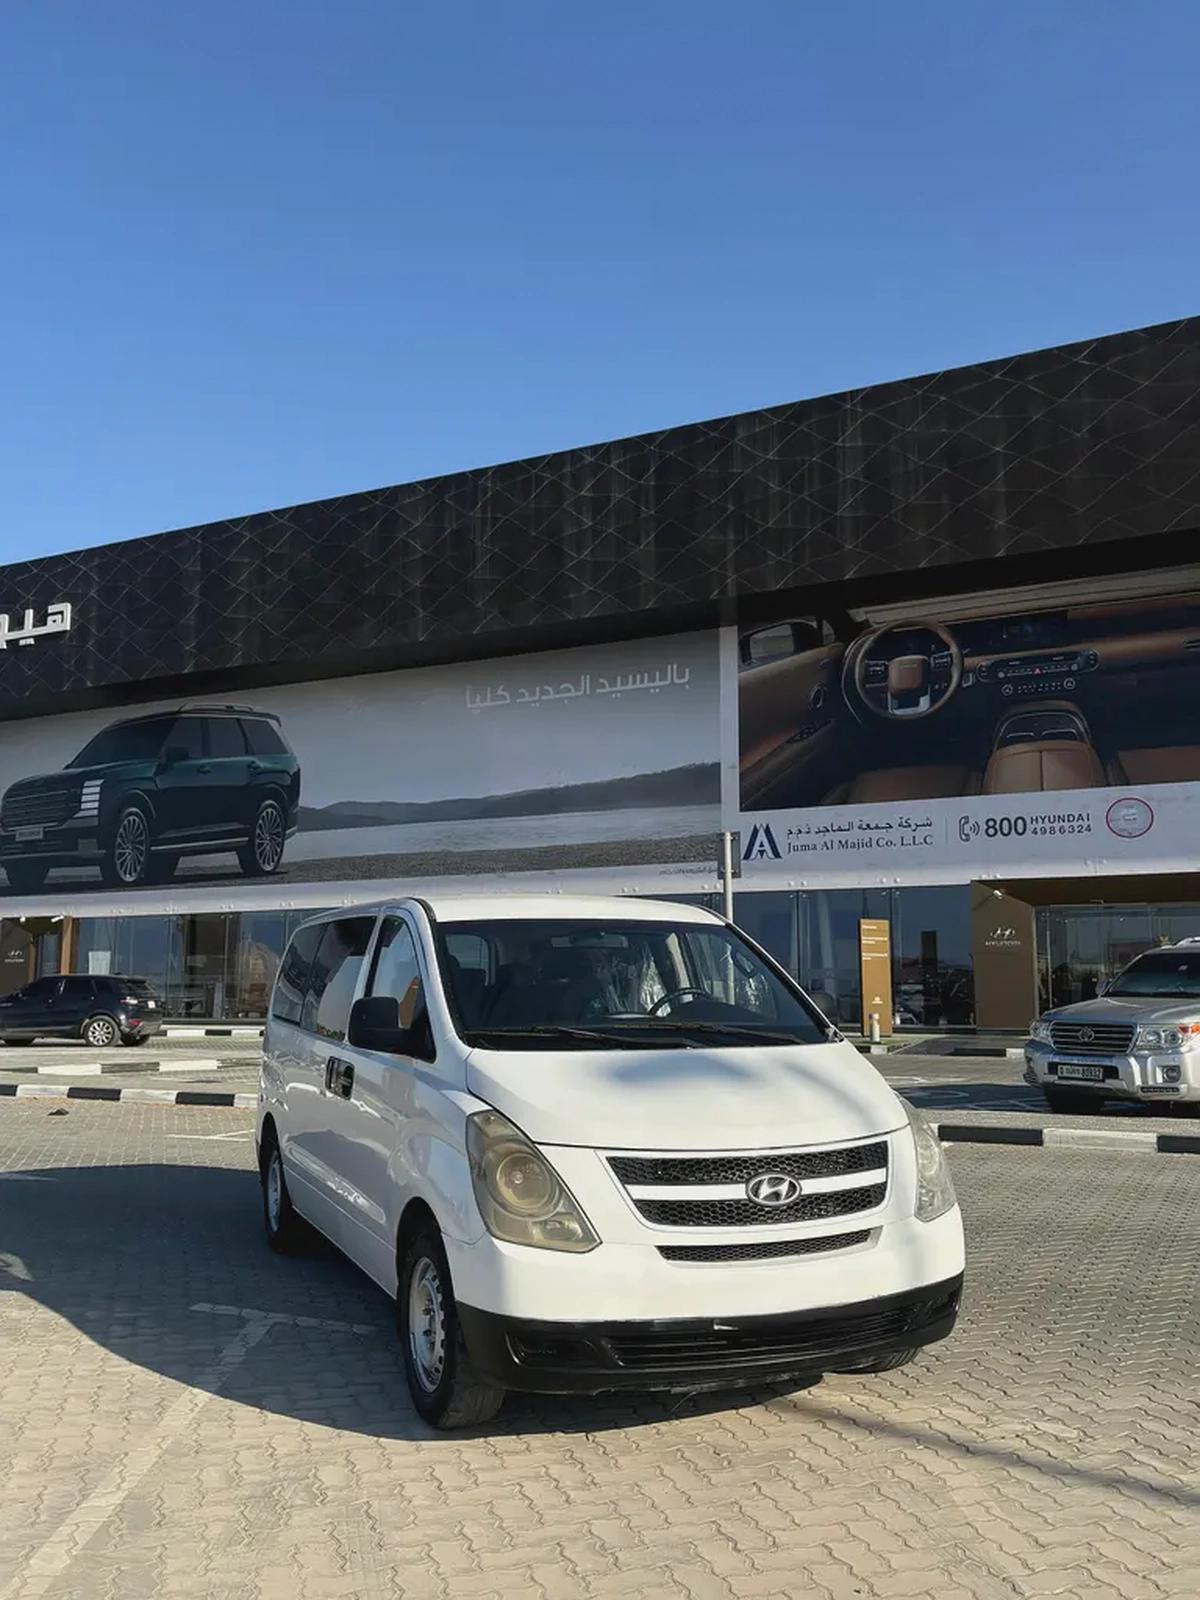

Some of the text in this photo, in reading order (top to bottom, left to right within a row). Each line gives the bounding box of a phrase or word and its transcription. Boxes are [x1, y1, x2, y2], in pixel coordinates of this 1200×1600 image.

[596, 664, 690, 698] باليسيد
[516, 675, 590, 707] الجديد
[815, 821, 854, 837] الماجد
[857, 819, 893, 833] جمعة
[898, 817, 933, 832] شركة
[984, 816, 1027, 838] 800
[1030, 812, 1090, 825] HYUNDAI
[1031, 824, 1092, 836] 4986324
[787, 835, 933, 854] Juma Al Majid Co. L.L.C
